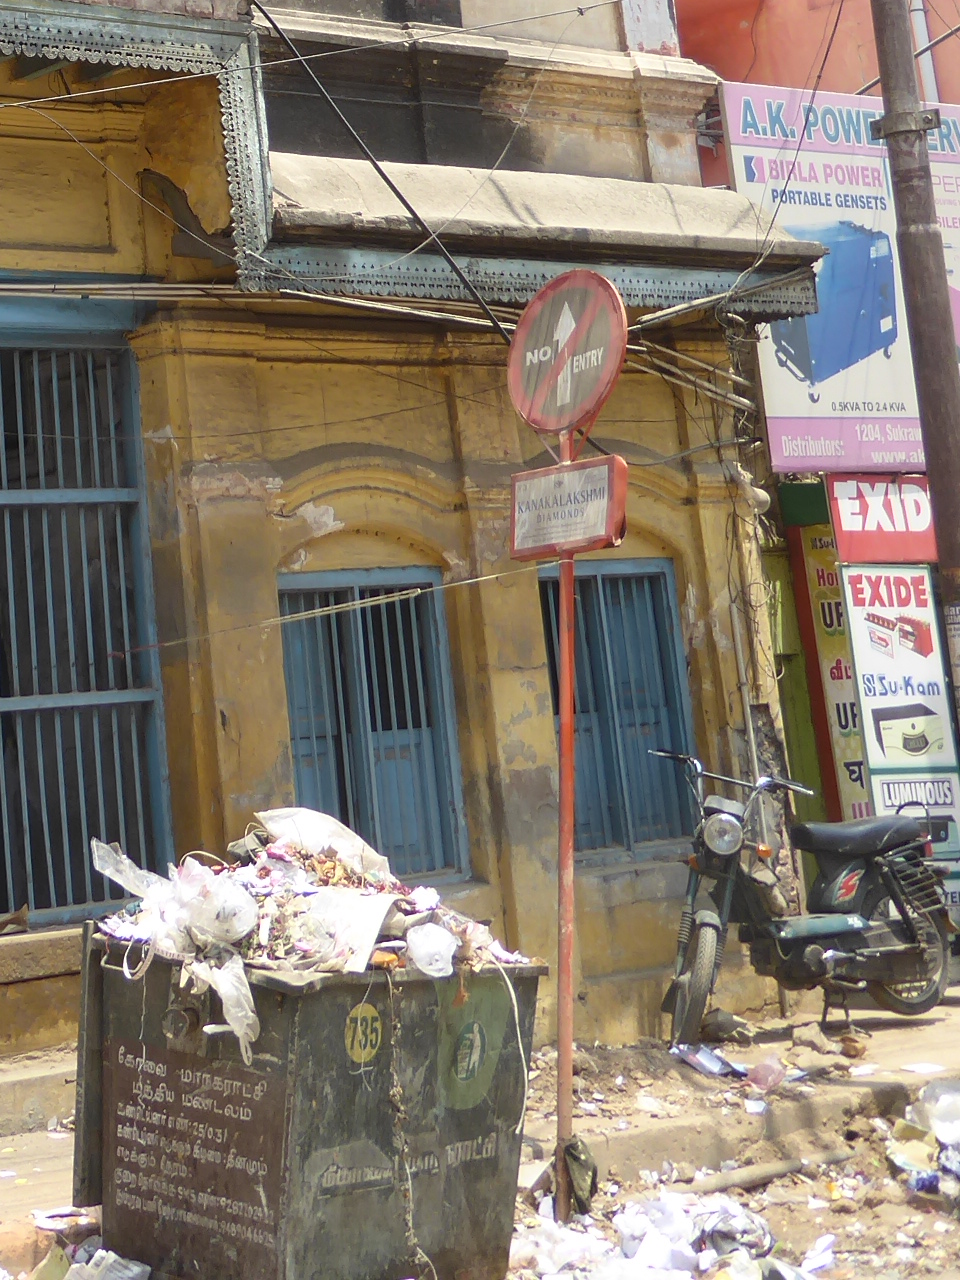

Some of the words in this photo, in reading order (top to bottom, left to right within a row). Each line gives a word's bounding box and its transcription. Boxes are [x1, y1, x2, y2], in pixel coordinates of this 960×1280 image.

[741, 98, 797, 139] A.K.
[802, 103, 890, 148] POWE
[768, 158, 820, 185] BIRLA
[824, 163, 884, 188] POWER
[771, 189, 833, 207] PORTABLE
[835, 194, 888, 211] GENSETS
[526, 345, 552, 366] NO
[573, 346, 604, 373] ENTRY
[831, 402, 860, 412] 0.5KVA
[862, 402, 873, 412] TO
[876, 402, 887, 412] 2.4
[890, 402, 906, 412] KVA
[782, 435, 845, 457] Distributors:
[517, 486, 606, 515] KANAKALAKSHMI
[833, 480, 933, 532] EXID
[537, 507, 585, 524] DIAMONDS
[848, 573, 929, 608] EXIDE
[883, 779, 953, 808] LUMINOUS
[348, 1015, 380, 1051] 735
[118, 1045, 167, 1077] கோவை
[180, 1068, 267, 1101] மாநகராட்சி
